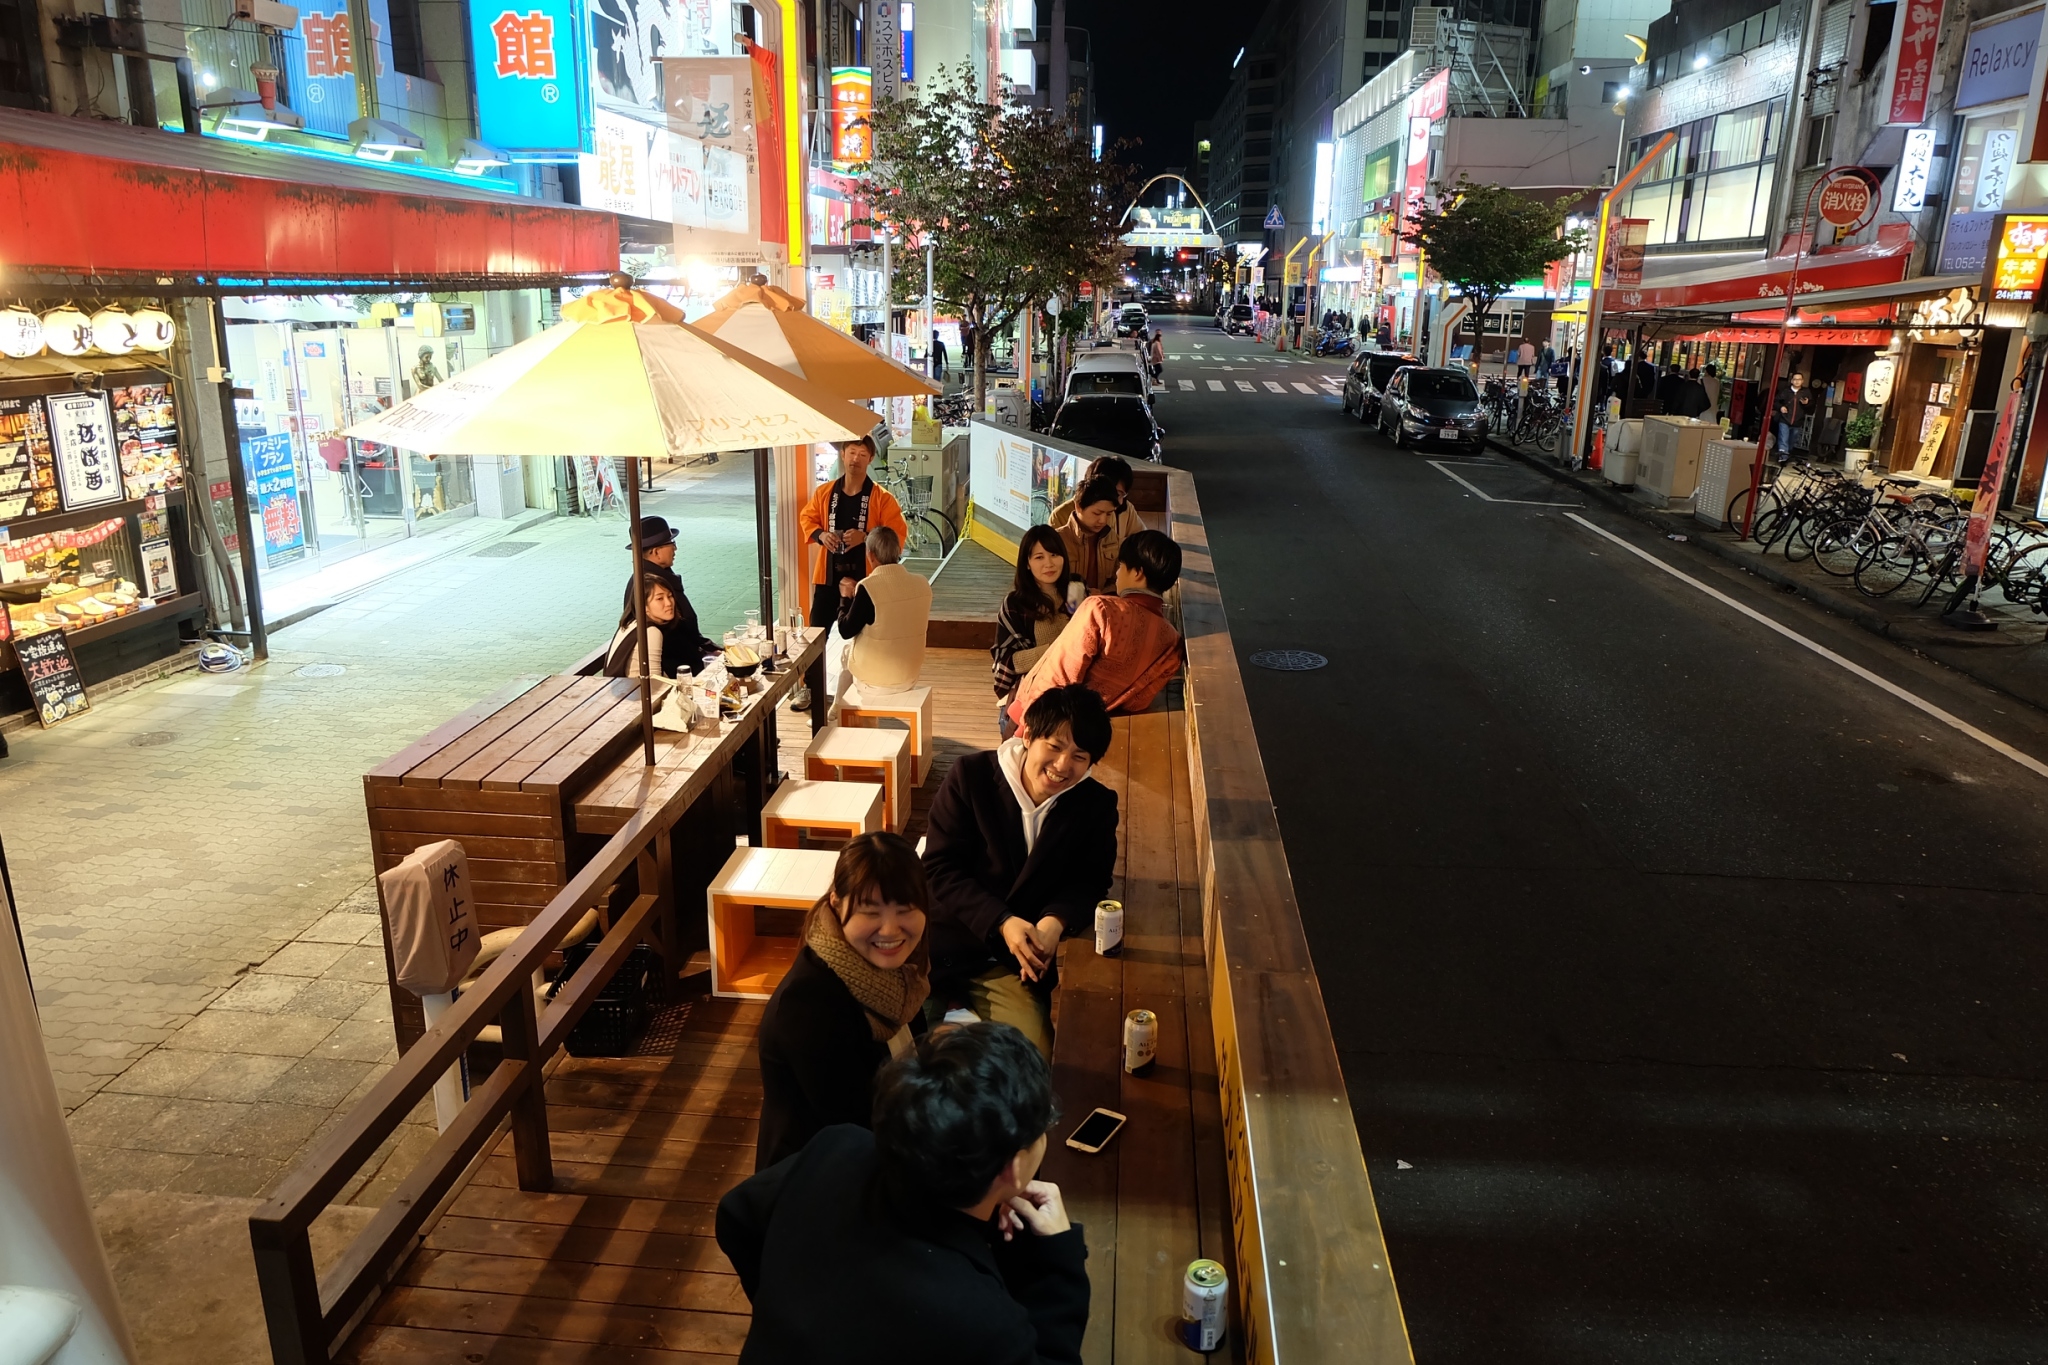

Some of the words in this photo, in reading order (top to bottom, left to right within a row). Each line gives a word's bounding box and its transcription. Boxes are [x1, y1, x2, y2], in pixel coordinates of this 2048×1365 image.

[1904, 0, 1939, 56] みや
[490, 10, 556, 79] 館
[882, 20, 894, 96] スマホスピタ
[1968, 39, 2036, 79] Relaxcy
[1908, 59, 1928, 102] 名古屋
[1893, 68, 1913, 118] コーチン
[713, 179, 743, 199] DRAGON
[713, 195, 747, 212] BANQUET
[1823, 191, 1866, 211] 消火栓
[1944, 258, 1954, 270] TEL
[1954, 256, 1987, 270] 052-2
[2002, 259, 2037, 274] 牛丼
[1998, 273, 2035, 289] カレー
[1995, 290, 2034, 300] 24H営業
[686, 413, 798, 432] プリンセス
[252, 436, 289, 455] ファミリー
[698, 427, 821, 447] パークレット
[1920, 420, 1943, 467] 営業中
[260, 451, 285, 468] プラン
[260, 476, 294, 495] 最大2時間
[264, 500, 300, 541] 無料
[28, 655, 72, 683] 大歓迎
[443, 863, 468, 952] 休止中
